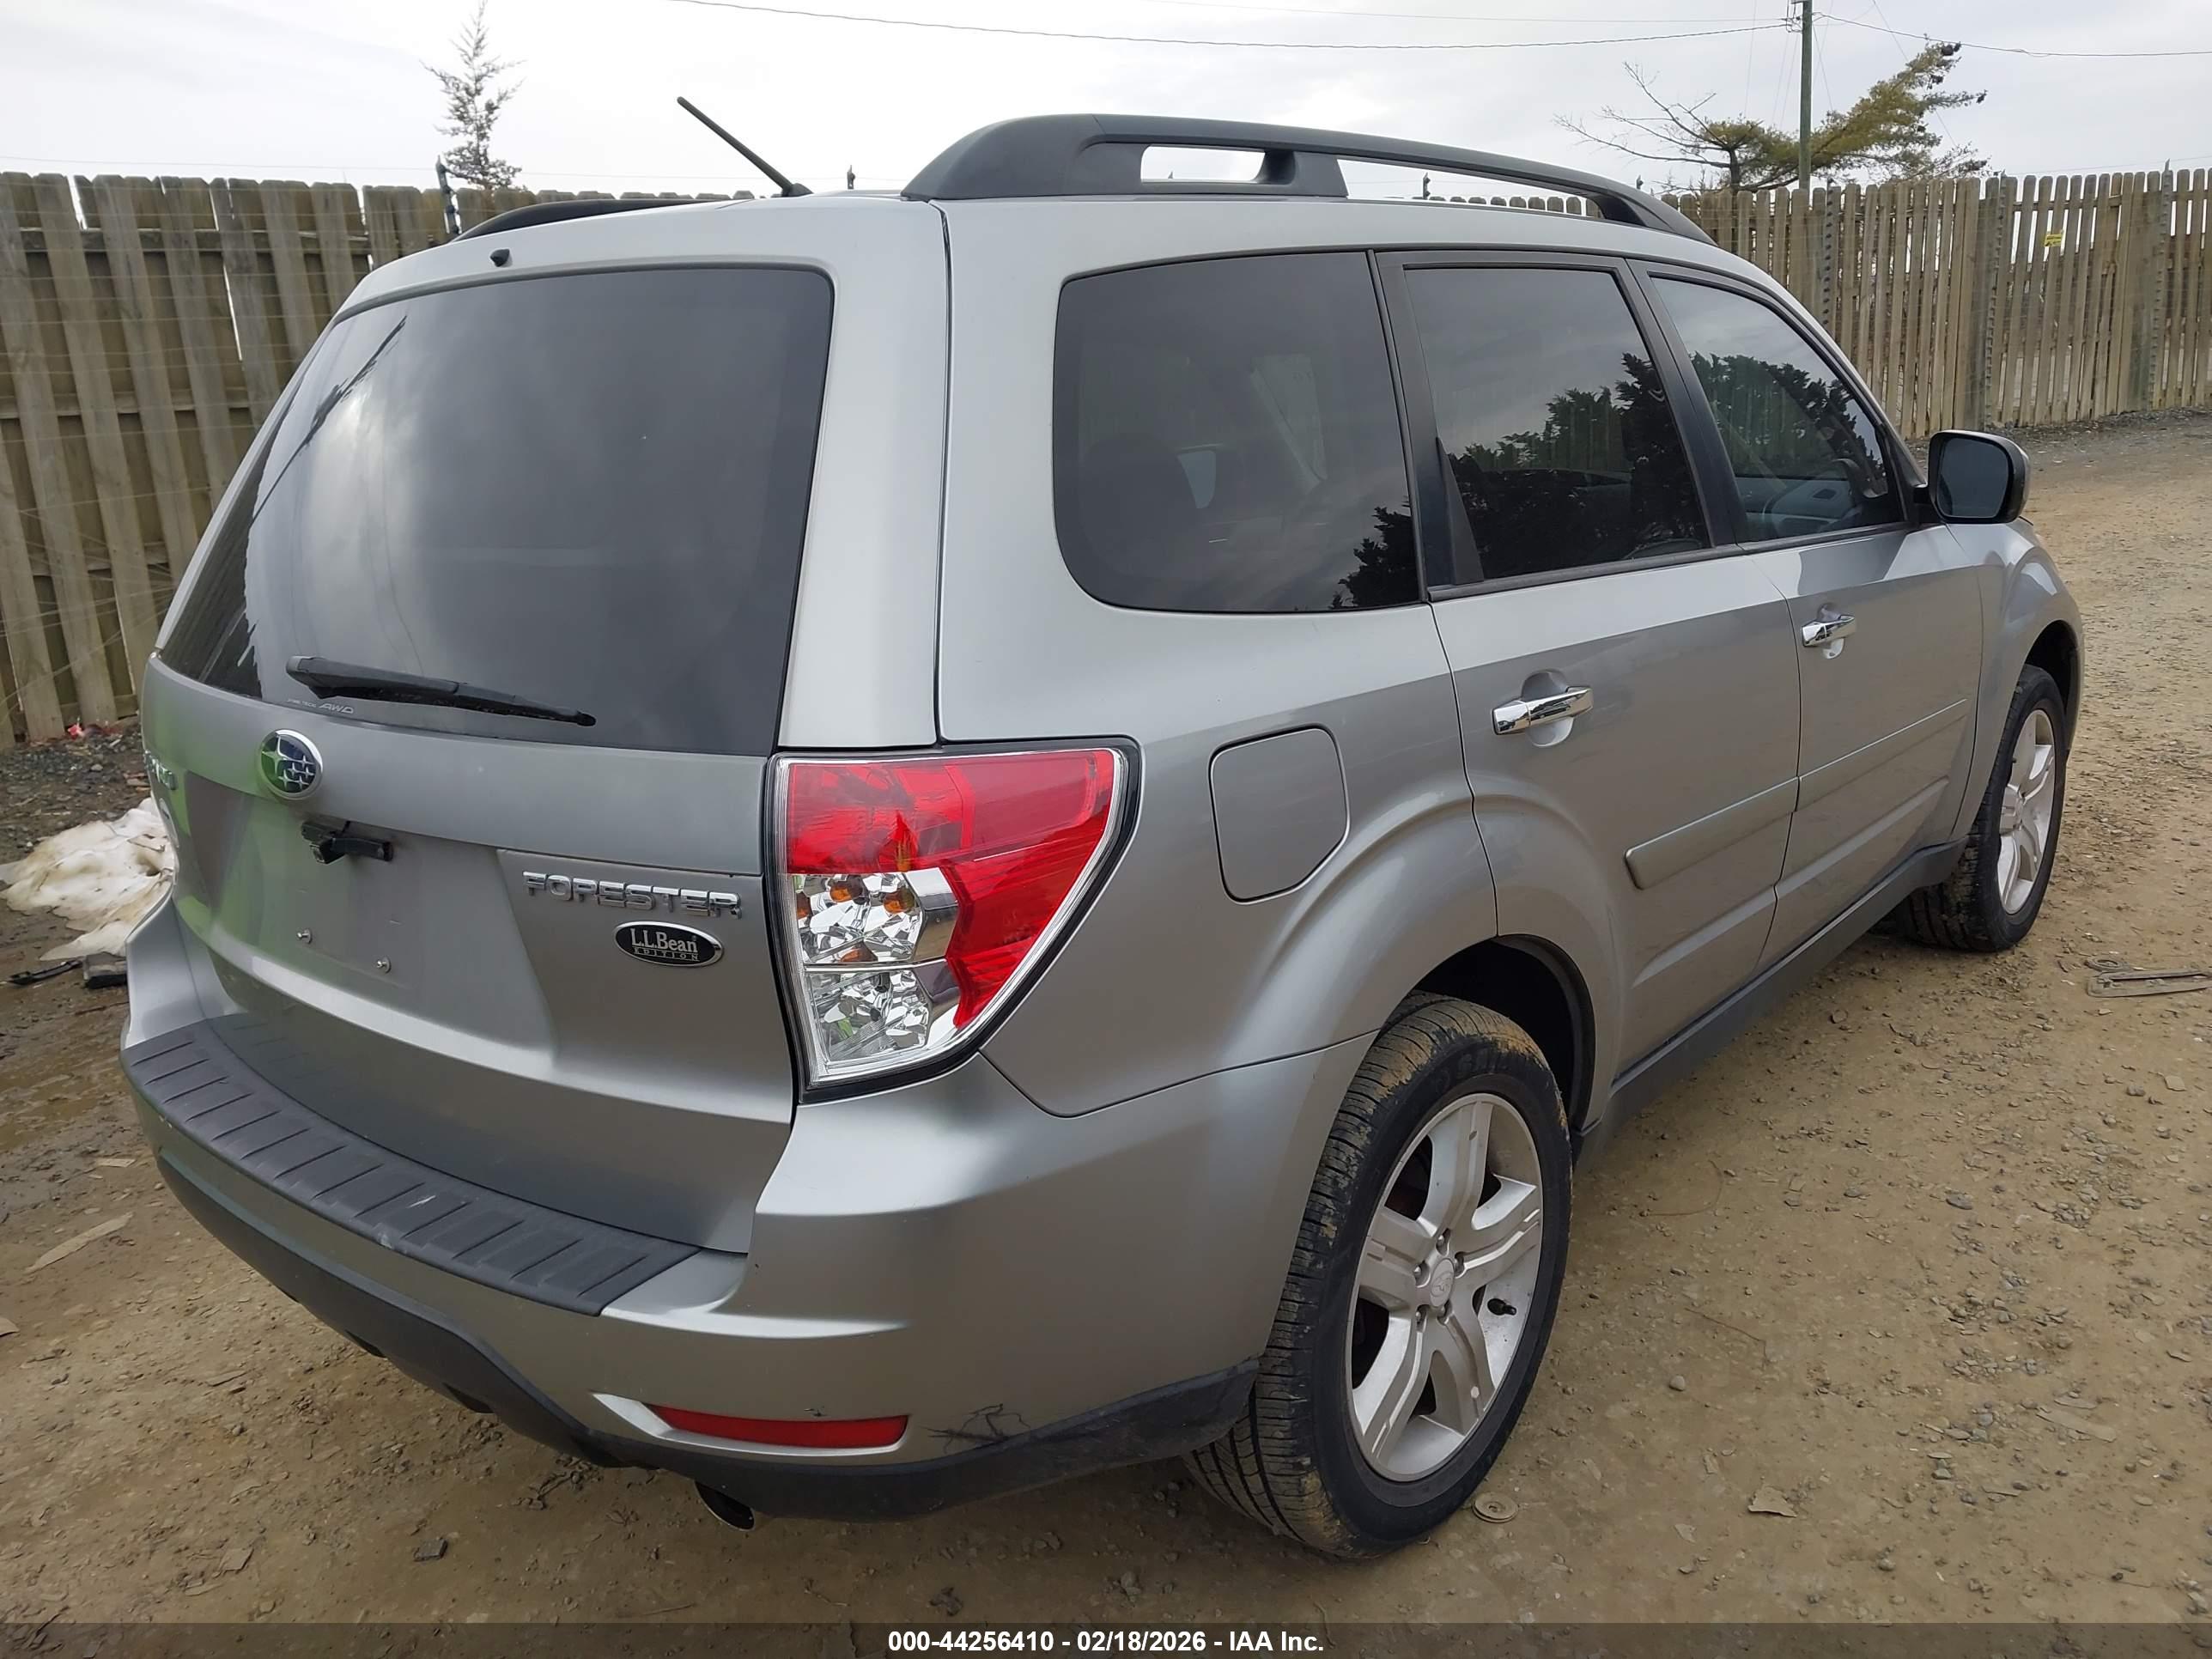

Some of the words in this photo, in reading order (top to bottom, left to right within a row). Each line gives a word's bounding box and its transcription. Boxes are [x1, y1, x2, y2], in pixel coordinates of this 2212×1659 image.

[319, 702, 354, 714] AWD
[522, 871, 743, 920] FORESTER
[630, 928, 698, 953] L.L.Bean
[633, 946, 700, 961] EDITION
